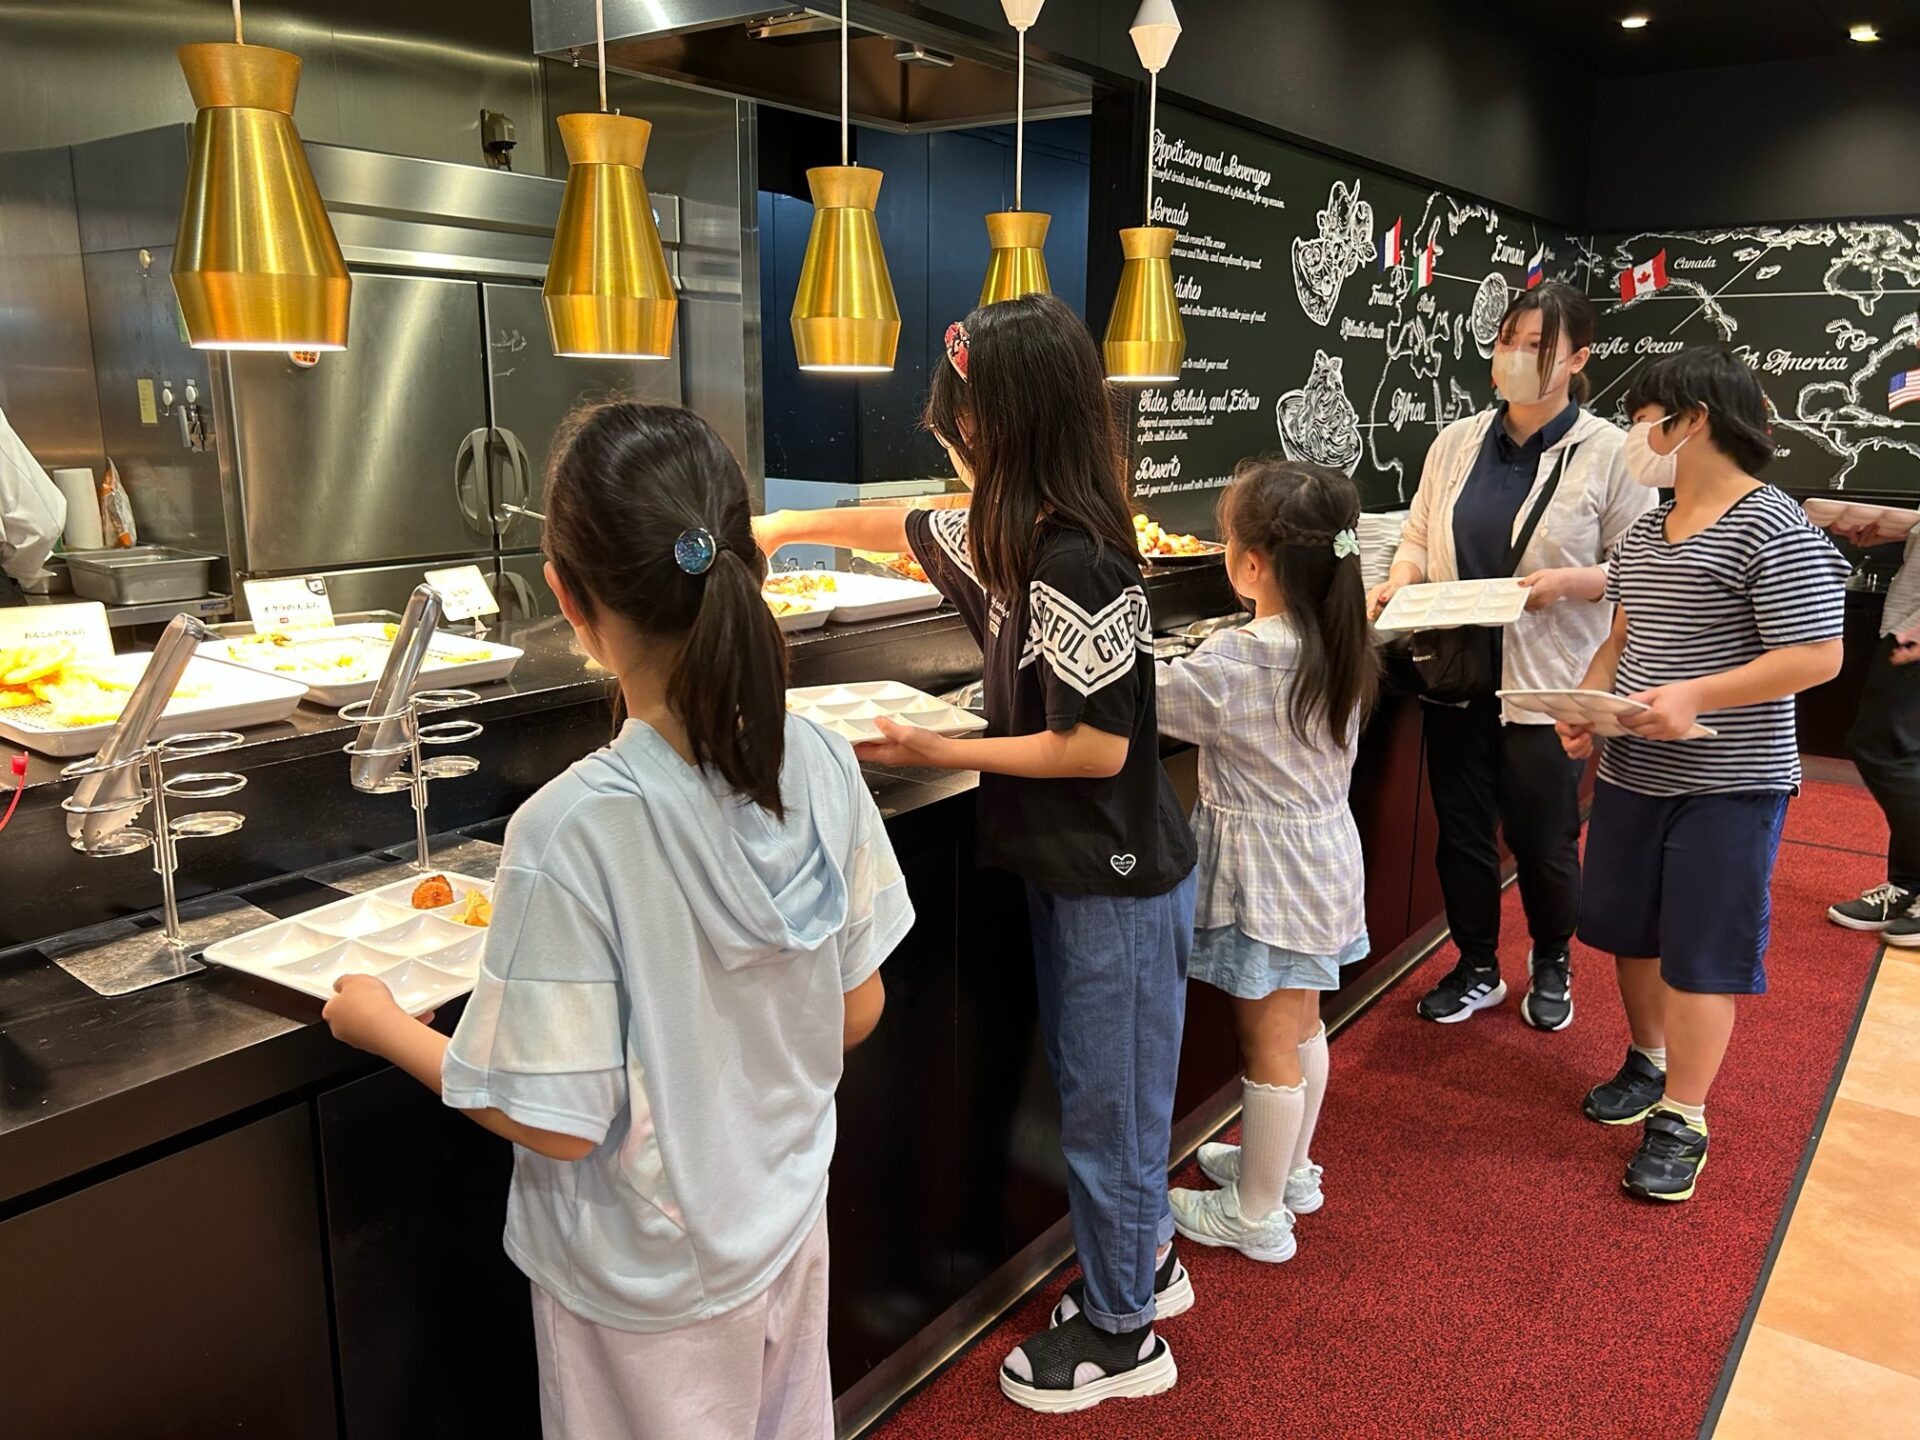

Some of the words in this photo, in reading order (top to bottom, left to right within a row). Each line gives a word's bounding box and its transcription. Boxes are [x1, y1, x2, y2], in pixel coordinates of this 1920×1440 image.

[1152, 128, 1202, 167] Appetizers
[1204, 151, 1224, 174] and
[1223, 155, 1271, 191] Beverages
[1150, 196, 1189, 226] Breads
[1673, 256, 1716, 271] Canada
[1174, 275, 1201, 300] dishes
[1368, 284, 1395, 307] France
[1340, 317, 1367, 342] Atlantic
[1366, 321, 1386, 340] Ocean
[1589, 337, 1629, 360] acific
[1633, 336, 1684, 354] Ocean
[1762, 349, 1848, 377] America
[1139, 389, 1168, 415] Sides,
[1171, 388, 1207, 414] Salads,
[1210, 389, 1229, 409] and
[1228, 388, 1260, 412] Extras
[1389, 388, 1426, 431] Africa
[1135, 455, 1181, 480] Desserts
[1043, 606, 1087, 665] RFUL
